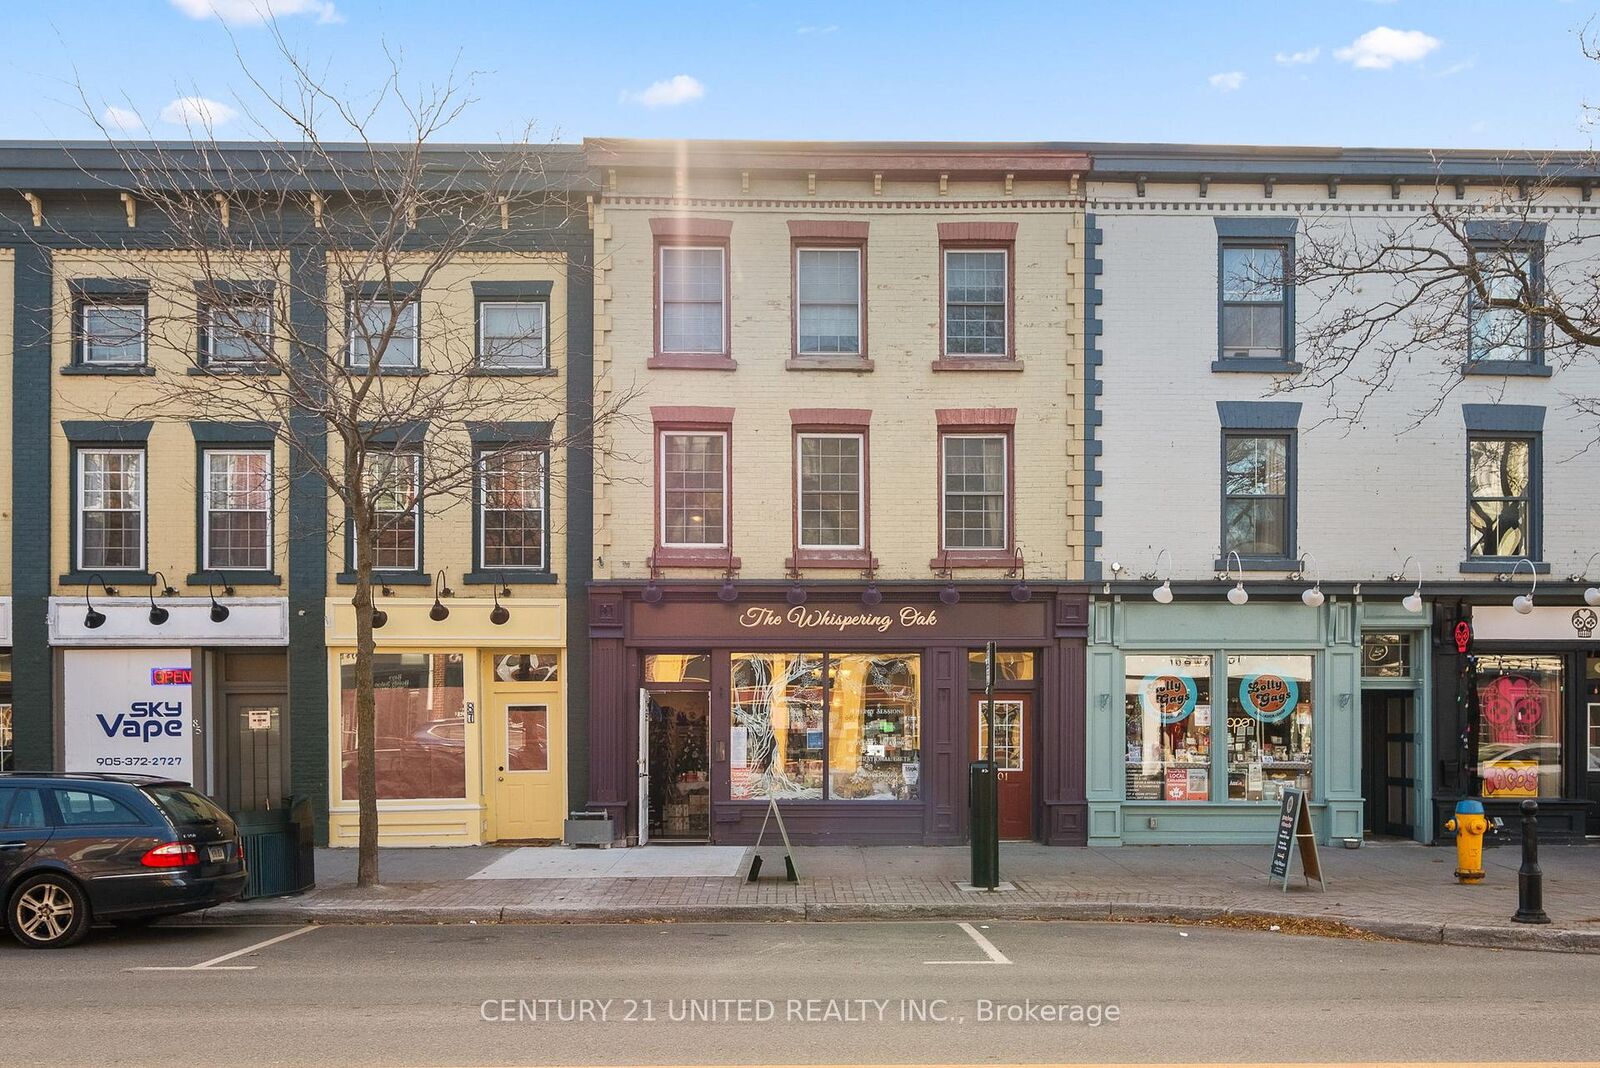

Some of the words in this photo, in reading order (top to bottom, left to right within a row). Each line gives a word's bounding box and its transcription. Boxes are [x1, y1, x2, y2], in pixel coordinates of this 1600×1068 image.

[739, 607, 782, 627] The
[787, 605, 894, 633] Whispering
[899, 606, 938, 627] Oak
[154, 671, 192, 683] OPEN
[1248, 680, 1282, 695] Lolly
[1256, 692, 1291, 707] Gags
[96, 713, 183, 742] Vape
[1226, 717, 1255, 734] open
[96, 757, 182, 766] 905-372-2727
[1483, 767, 1537, 794] TACOS
